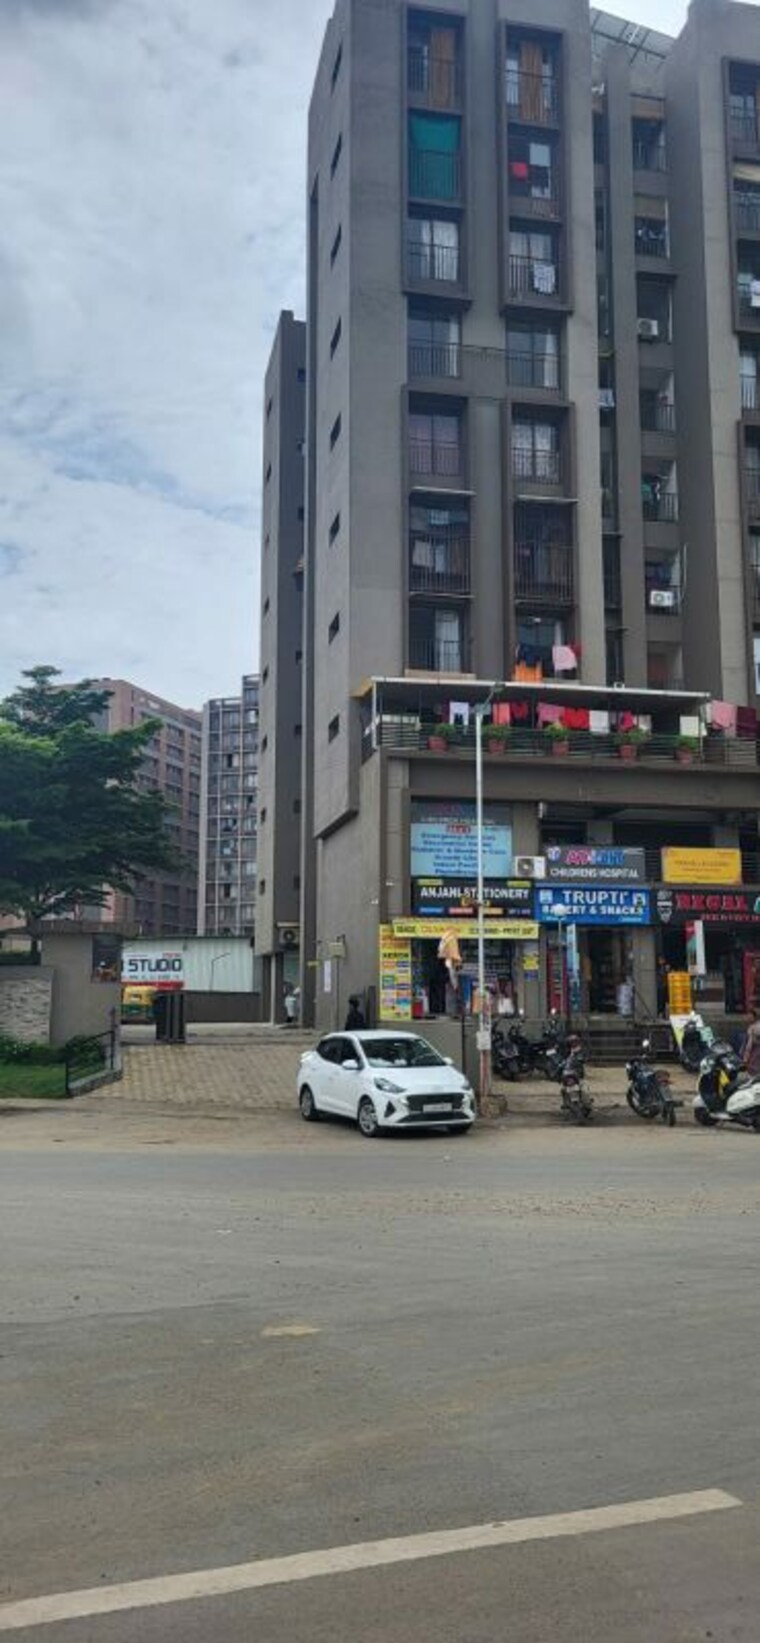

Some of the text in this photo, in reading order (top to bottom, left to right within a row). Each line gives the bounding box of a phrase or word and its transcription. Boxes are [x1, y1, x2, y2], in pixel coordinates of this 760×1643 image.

[599, 868, 639, 878] HOSPITAL
[562, 890, 625, 904] TRUPTI
[128, 958, 182, 972] STUDIO
